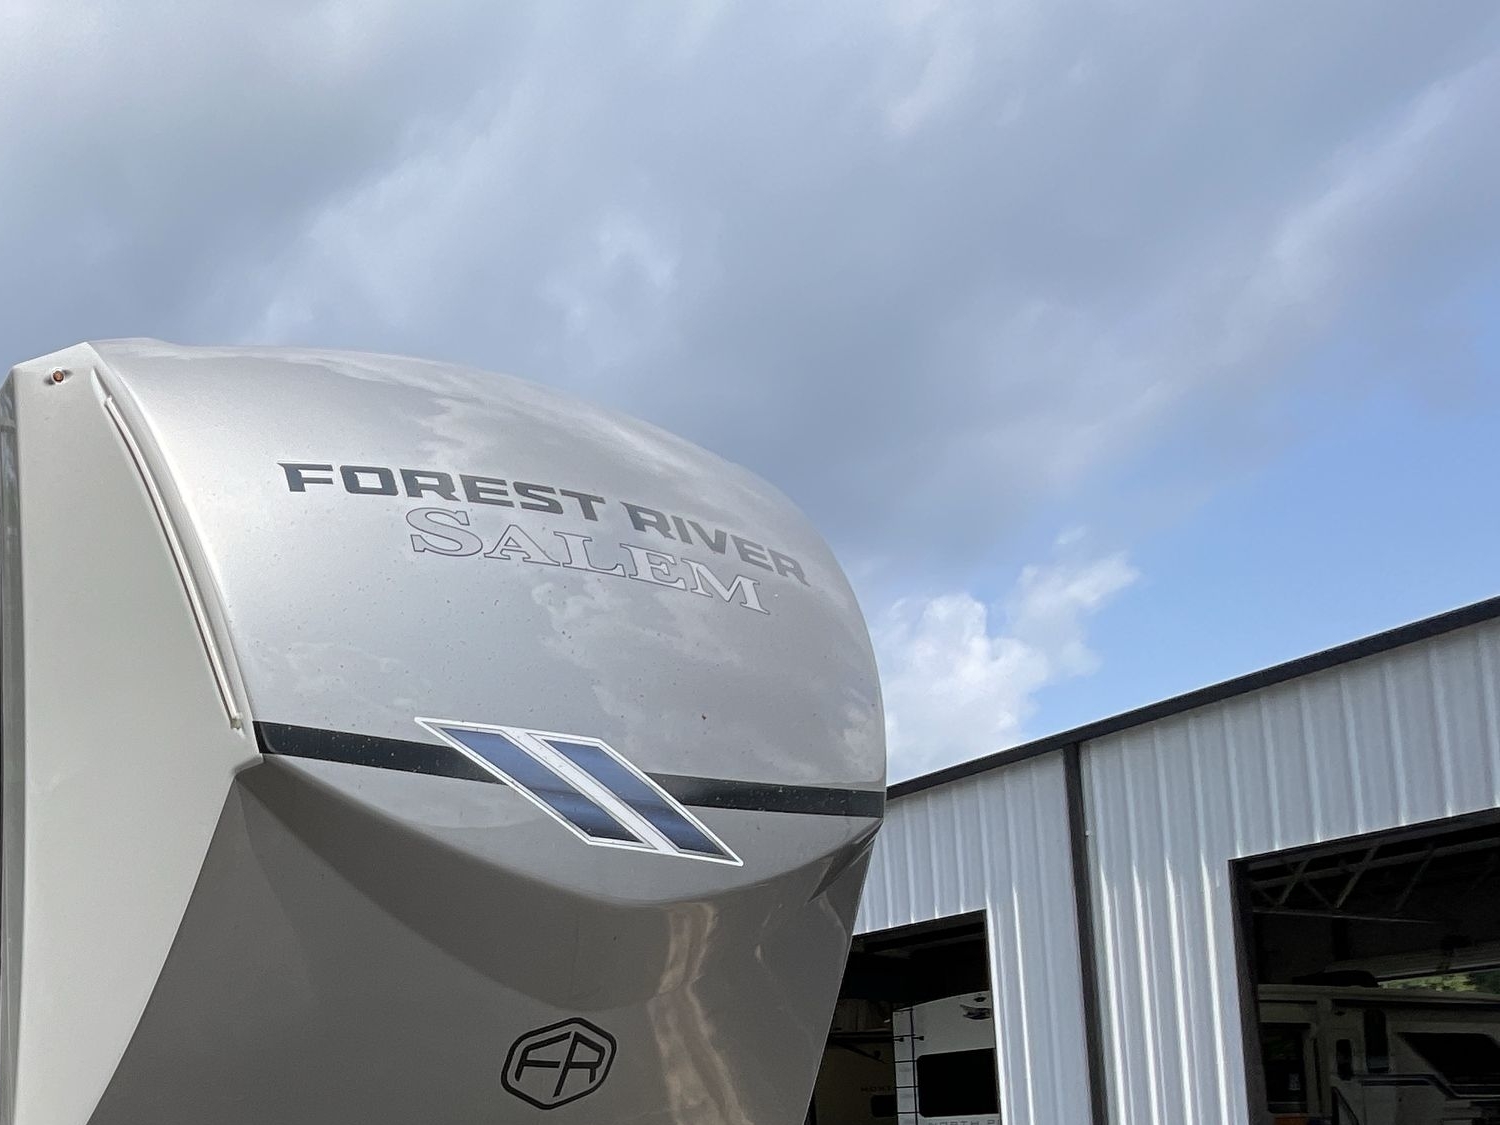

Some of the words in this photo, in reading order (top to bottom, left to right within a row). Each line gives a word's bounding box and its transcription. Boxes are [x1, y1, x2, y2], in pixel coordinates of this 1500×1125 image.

[277, 462, 606, 521] FOREST
[621, 502, 811, 586] RIVER
[405, 506, 771, 615] SALEM
